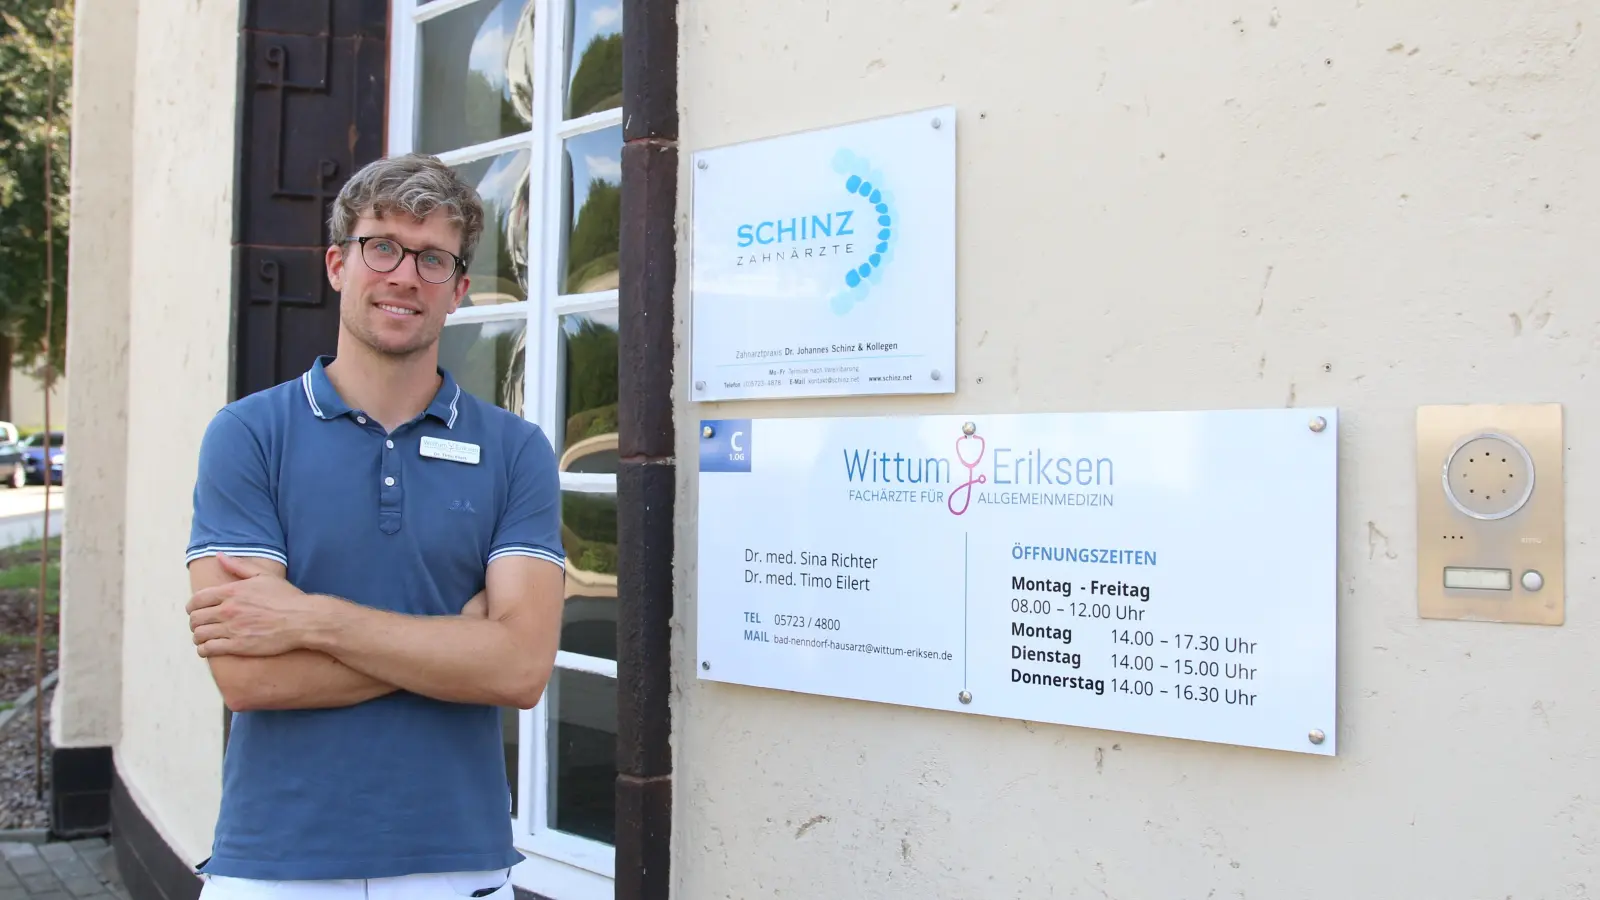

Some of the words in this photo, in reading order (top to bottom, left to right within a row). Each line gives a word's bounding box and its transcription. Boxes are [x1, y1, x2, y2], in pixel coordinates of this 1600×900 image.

[737, 210, 854, 247] SCHINZ
[737, 243, 854, 266] ZAHNÄRZTE
[736, 349, 782, 360] Zahnarztpraxis
[784, 347, 794, 356] Dr.
[797, 345, 829, 355] Johannes
[831, 344, 856, 353] Schinz
[858, 342, 863, 352] &
[866, 342, 898, 352] Kollegen
[723, 381, 741, 389] Telefon
[789, 377, 806, 385] E-Mail
[868, 374, 912, 382] www.schinz.net
[731, 431, 743, 452] C
[843, 448, 950, 483] Wittum
[993, 448, 1113, 485] Eriksen
[849, 487, 917, 503] FACHÄRZTE
[921, 488, 944, 503] FÜR
[977, 492, 1114, 507] ALLGEMEINMEDIZIN
[745, 549, 762, 563] Dr.
[766, 550, 797, 565] med.
[800, 551, 827, 566] Sina
[831, 553, 878, 569] Richter
[1011, 542, 1157, 565] ÖFFNUNGSZEITEN
[744, 570, 762, 584] Dr.
[766, 572, 796, 586] med.
[800, 573, 832, 588] Timo
[836, 575, 870, 591] Eilert
[1011, 576, 1072, 597] Montag
[1090, 580, 1150, 602] Freitag
[1011, 598, 1051, 615] 08.00
[1069, 602, 1111, 619] 12.00
[1116, 605, 1146, 621] Uhr
[744, 612, 761, 624] TEL
[774, 614, 805, 628] 05723
[814, 617, 840, 631] 4800
[744, 630, 769, 643] MAIL
[774, 634, 952, 661] bad-nenndorf-hausarzt@wittum-eriksen.de
[1011, 622, 1072, 644] Montag
[1111, 629, 1154, 647] 14.00
[1174, 634, 1219, 652] 17.30
[1225, 637, 1257, 654] Uhr
[1011, 645, 1081, 669] Dienstag
[1111, 653, 1154, 671] 14.00
[1174, 659, 1219, 677] 15.00
[1225, 662, 1257, 680] Uhr
[1011, 668, 1105, 695] Donnerstag
[1111, 678, 1154, 696] 14.00
[1174, 684, 1219, 703] 16.30
[1225, 687, 1257, 706] Uhr
